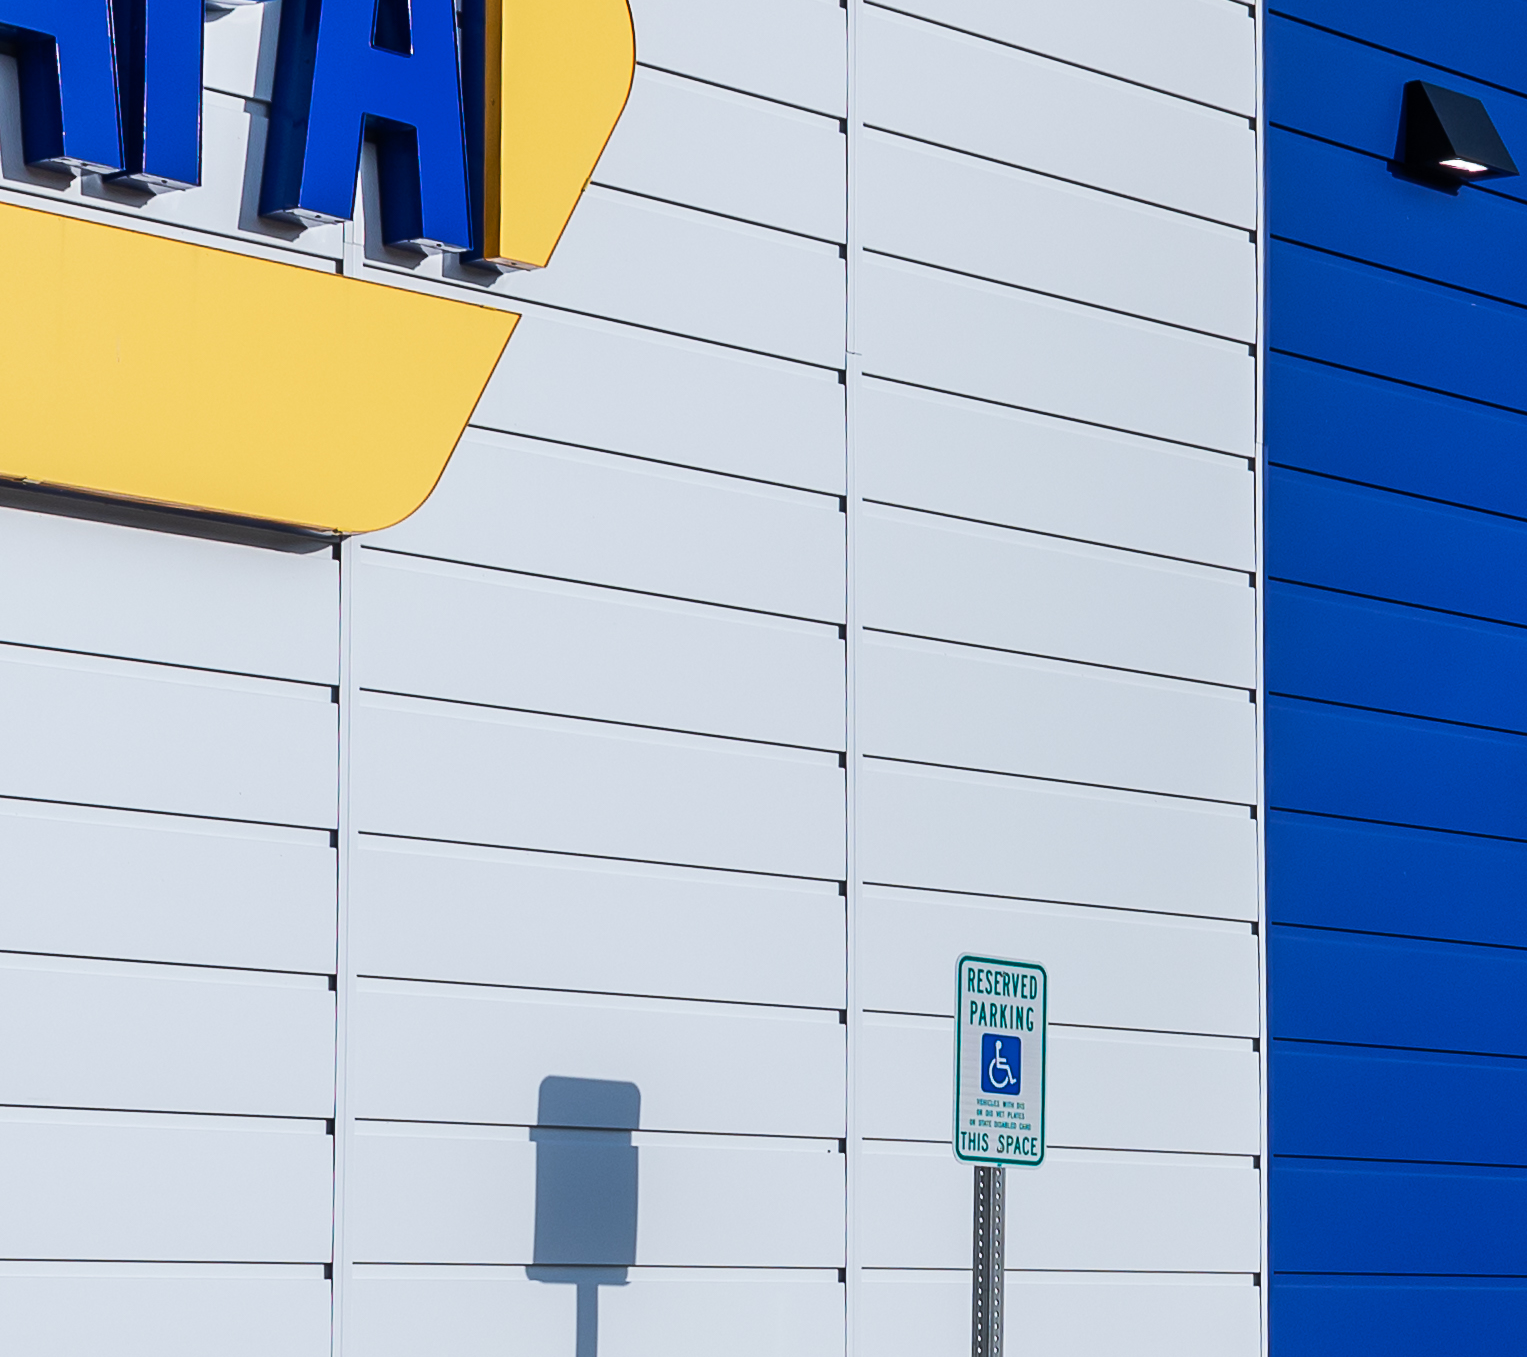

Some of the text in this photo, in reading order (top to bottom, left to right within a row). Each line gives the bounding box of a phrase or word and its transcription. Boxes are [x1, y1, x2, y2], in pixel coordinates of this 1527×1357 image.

[967, 967, 1038, 1000] RESERVED
[969, 1000, 1035, 1032] PARKING
[960, 1131, 1038, 1156] THIS SPACE
